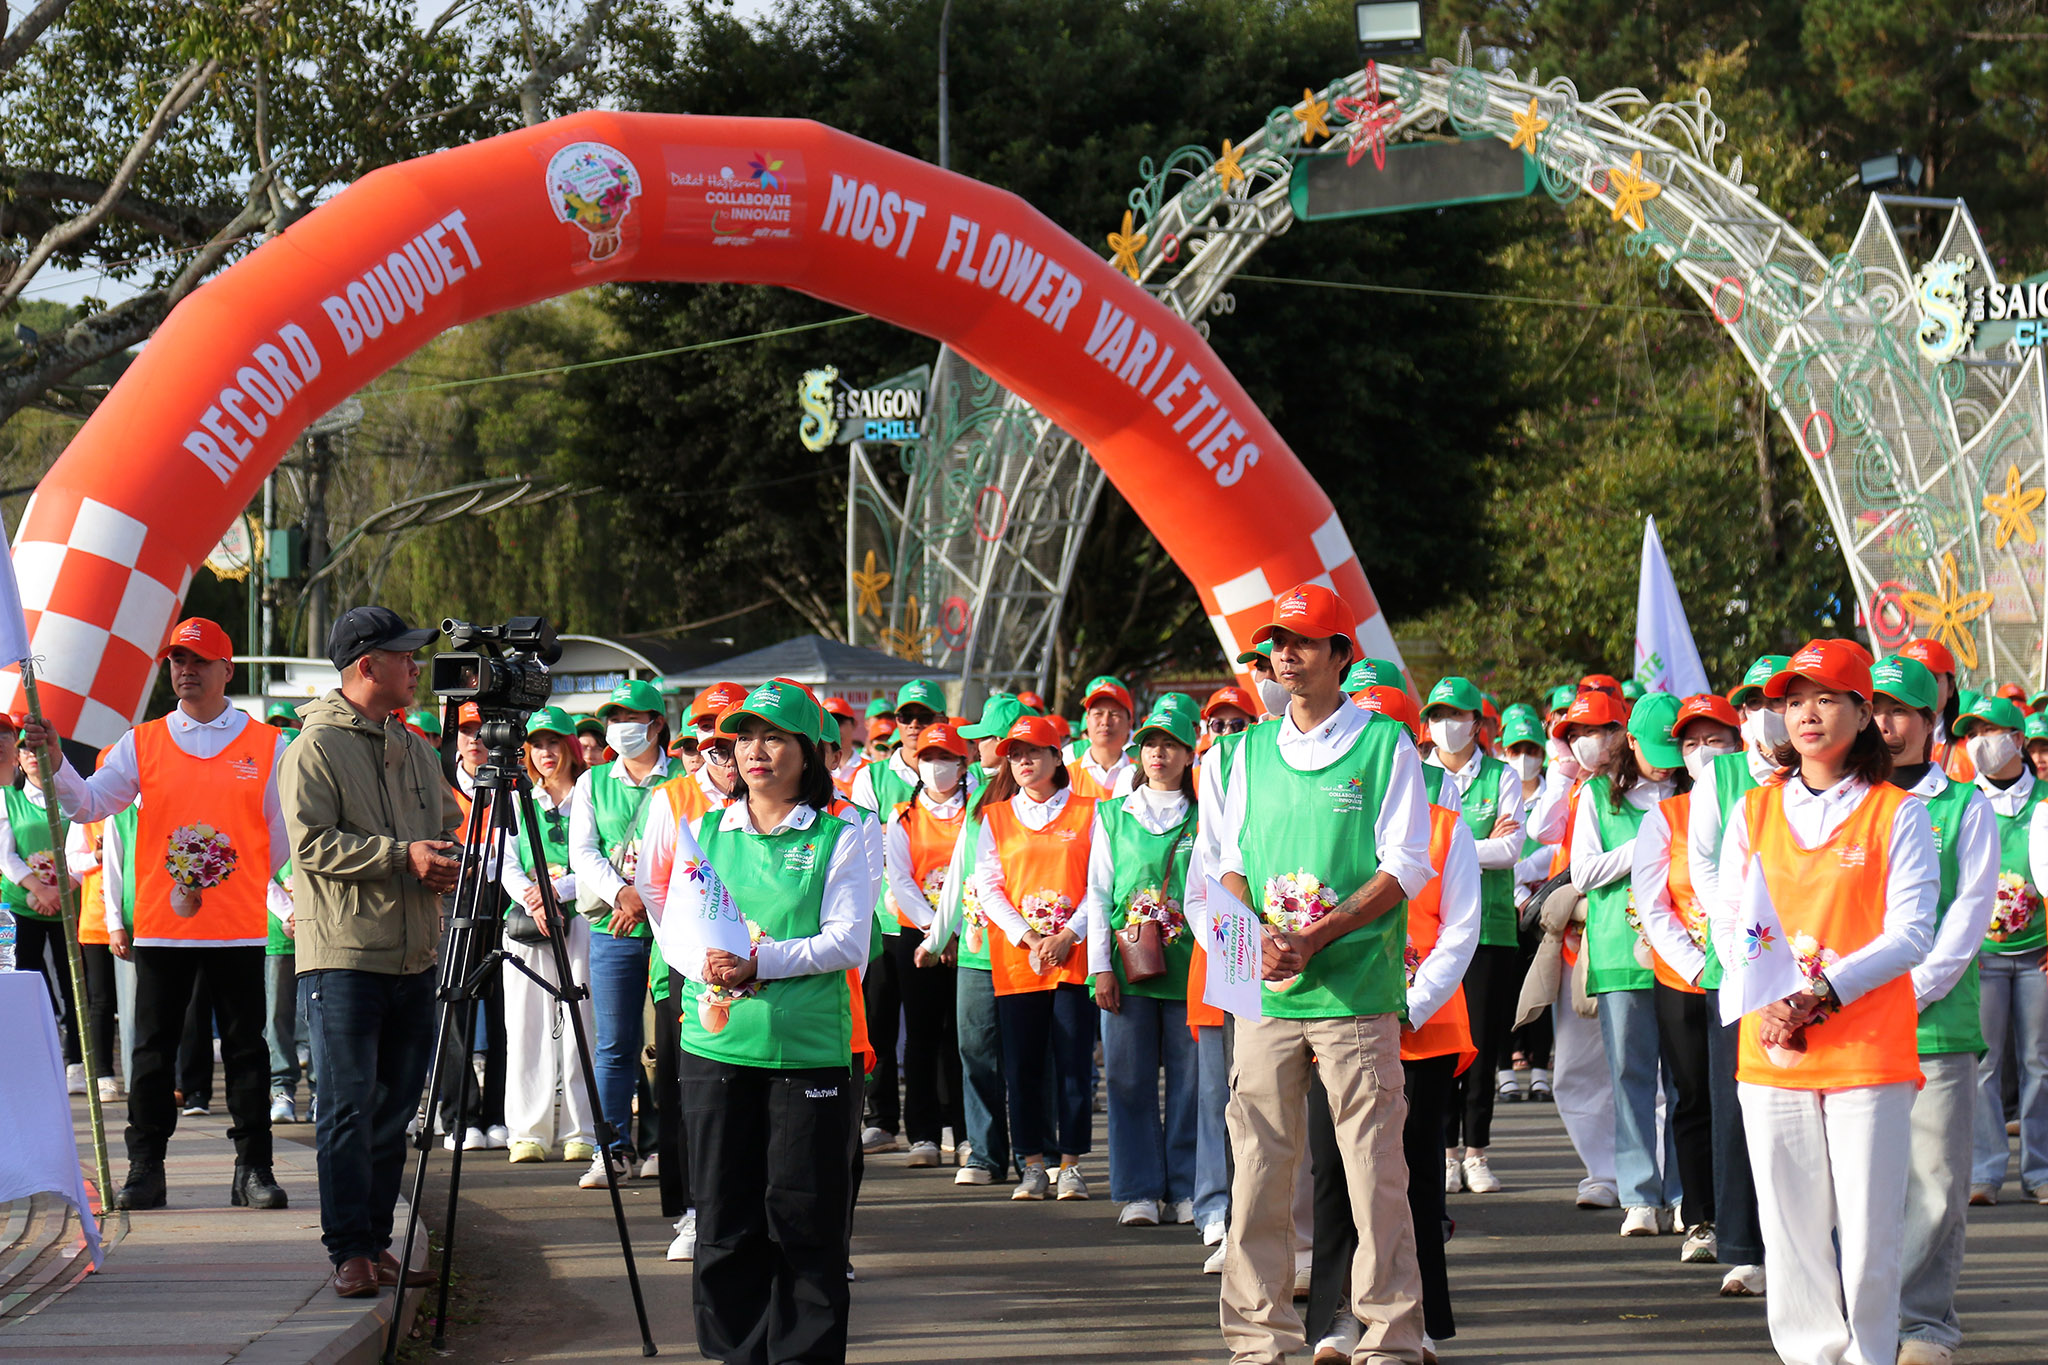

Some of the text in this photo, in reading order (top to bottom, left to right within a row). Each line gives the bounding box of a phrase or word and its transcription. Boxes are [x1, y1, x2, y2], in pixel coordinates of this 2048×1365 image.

[671, 172, 704, 186] Dalat
[705, 192, 791, 206] COLLABORATE
[731, 207, 791, 222] INNOVATE
[820, 173, 1261, 487] MOST FLOWER VARIETIES
[183, 209, 482, 485] RECORD BOUQUET
[847, 388, 921, 418] SAIGON
[864, 420, 920, 440] CHILL
[1229, 912, 1238, 985] COLLABORATE
[1237, 916, 1245, 966] INNOVATE
